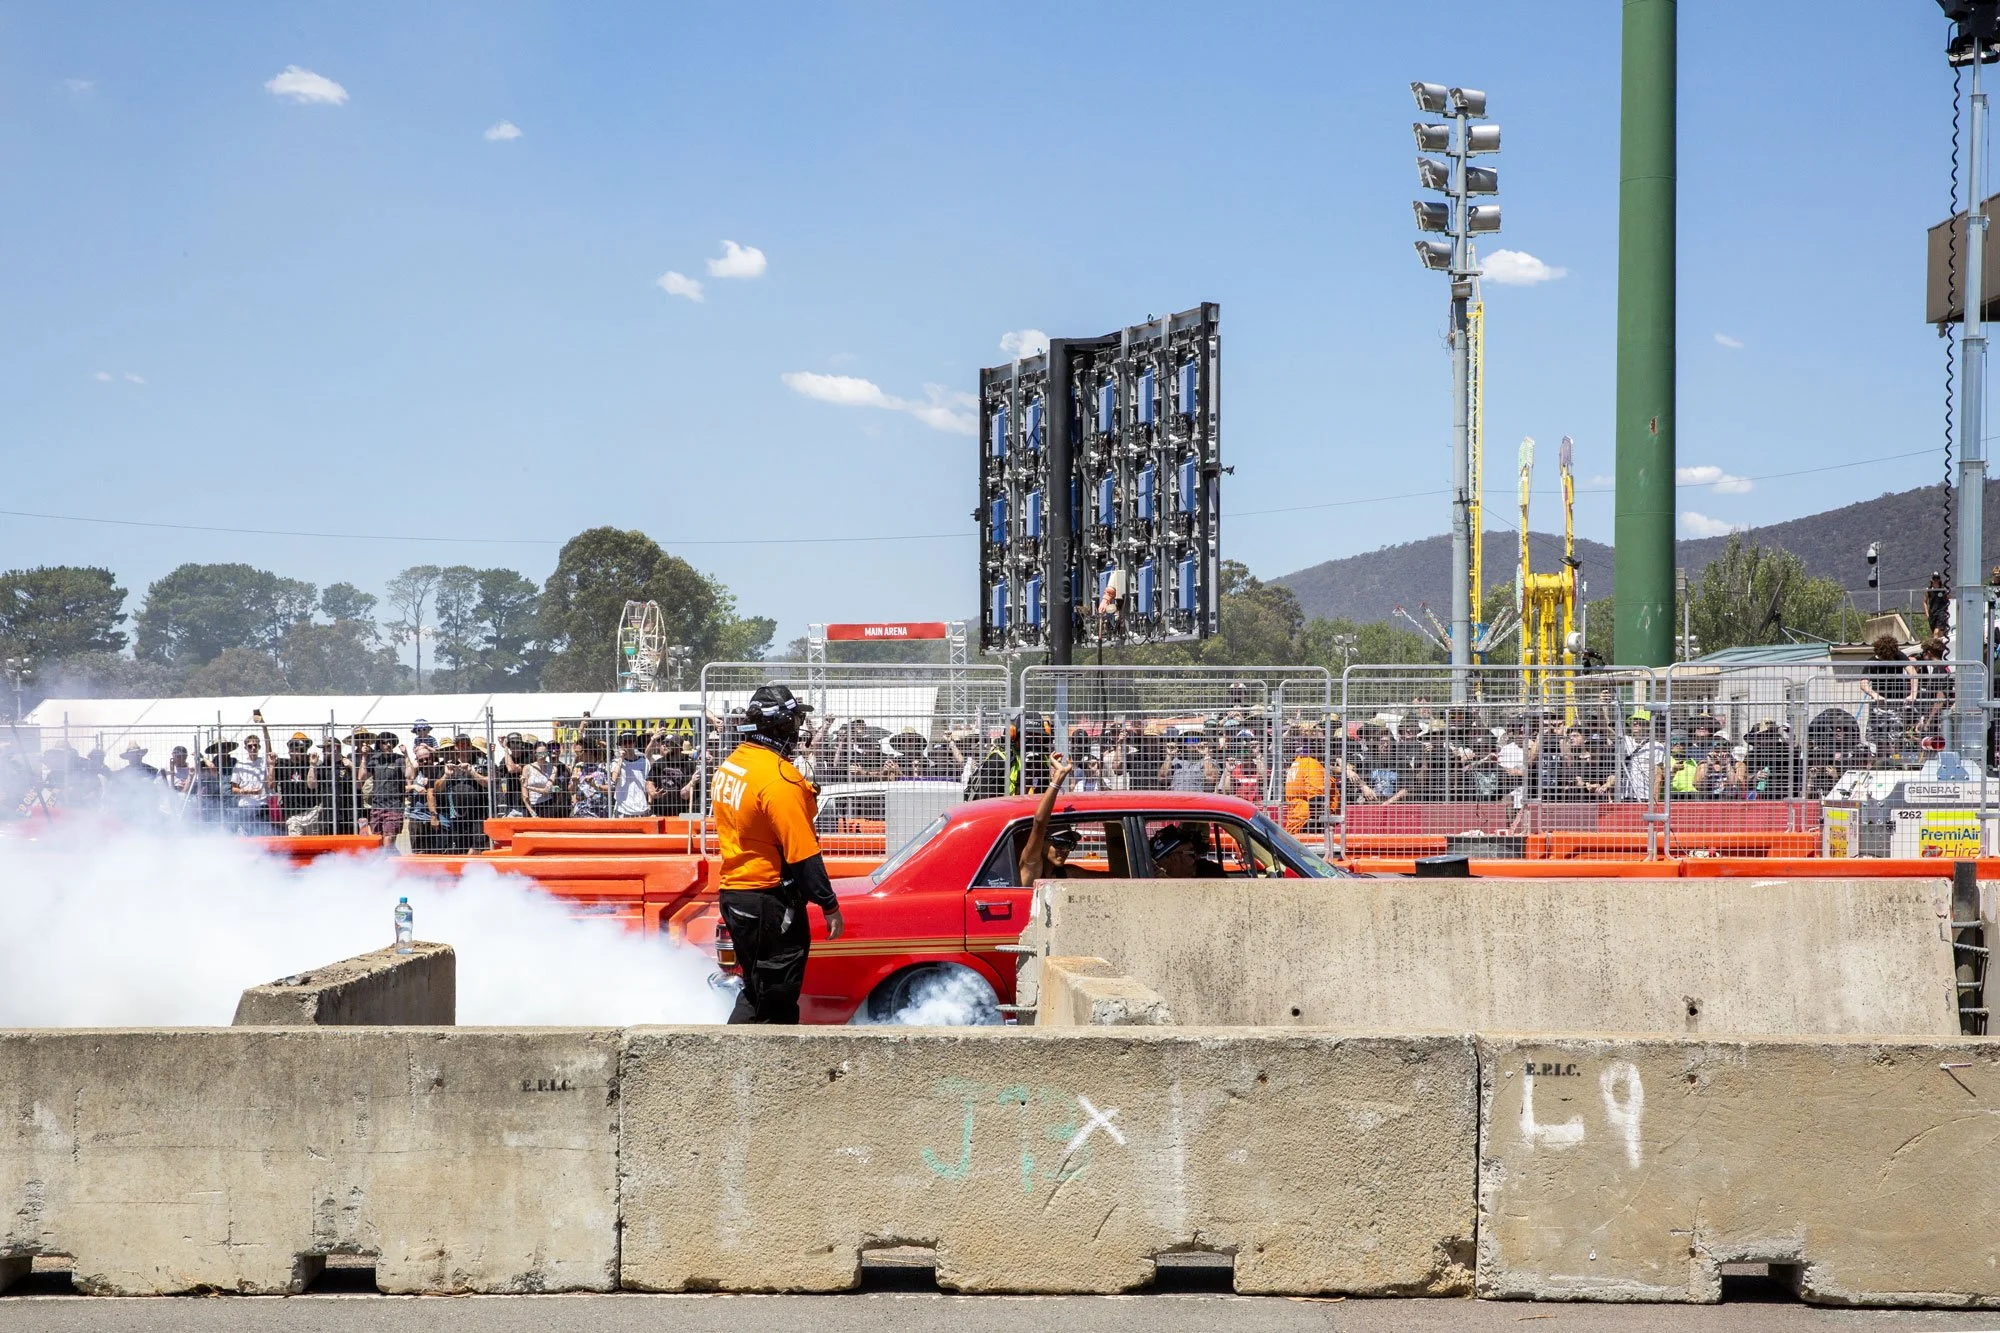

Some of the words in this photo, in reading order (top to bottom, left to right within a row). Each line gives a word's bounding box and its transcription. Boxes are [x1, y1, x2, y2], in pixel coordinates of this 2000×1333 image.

[864, 627, 883, 636] MAIN
[884, 626, 907, 636] ARENA
[1908, 786, 1960, 794] GENERAC
[1897, 810, 1922, 819] 1262
[1921, 828, 1981, 840] PremiAir
[1944, 843, 1981, 858] Hire
[1526, 1063, 1581, 1077] E.P.I.C.
[521, 1079, 577, 1091] E.P.I.C.
